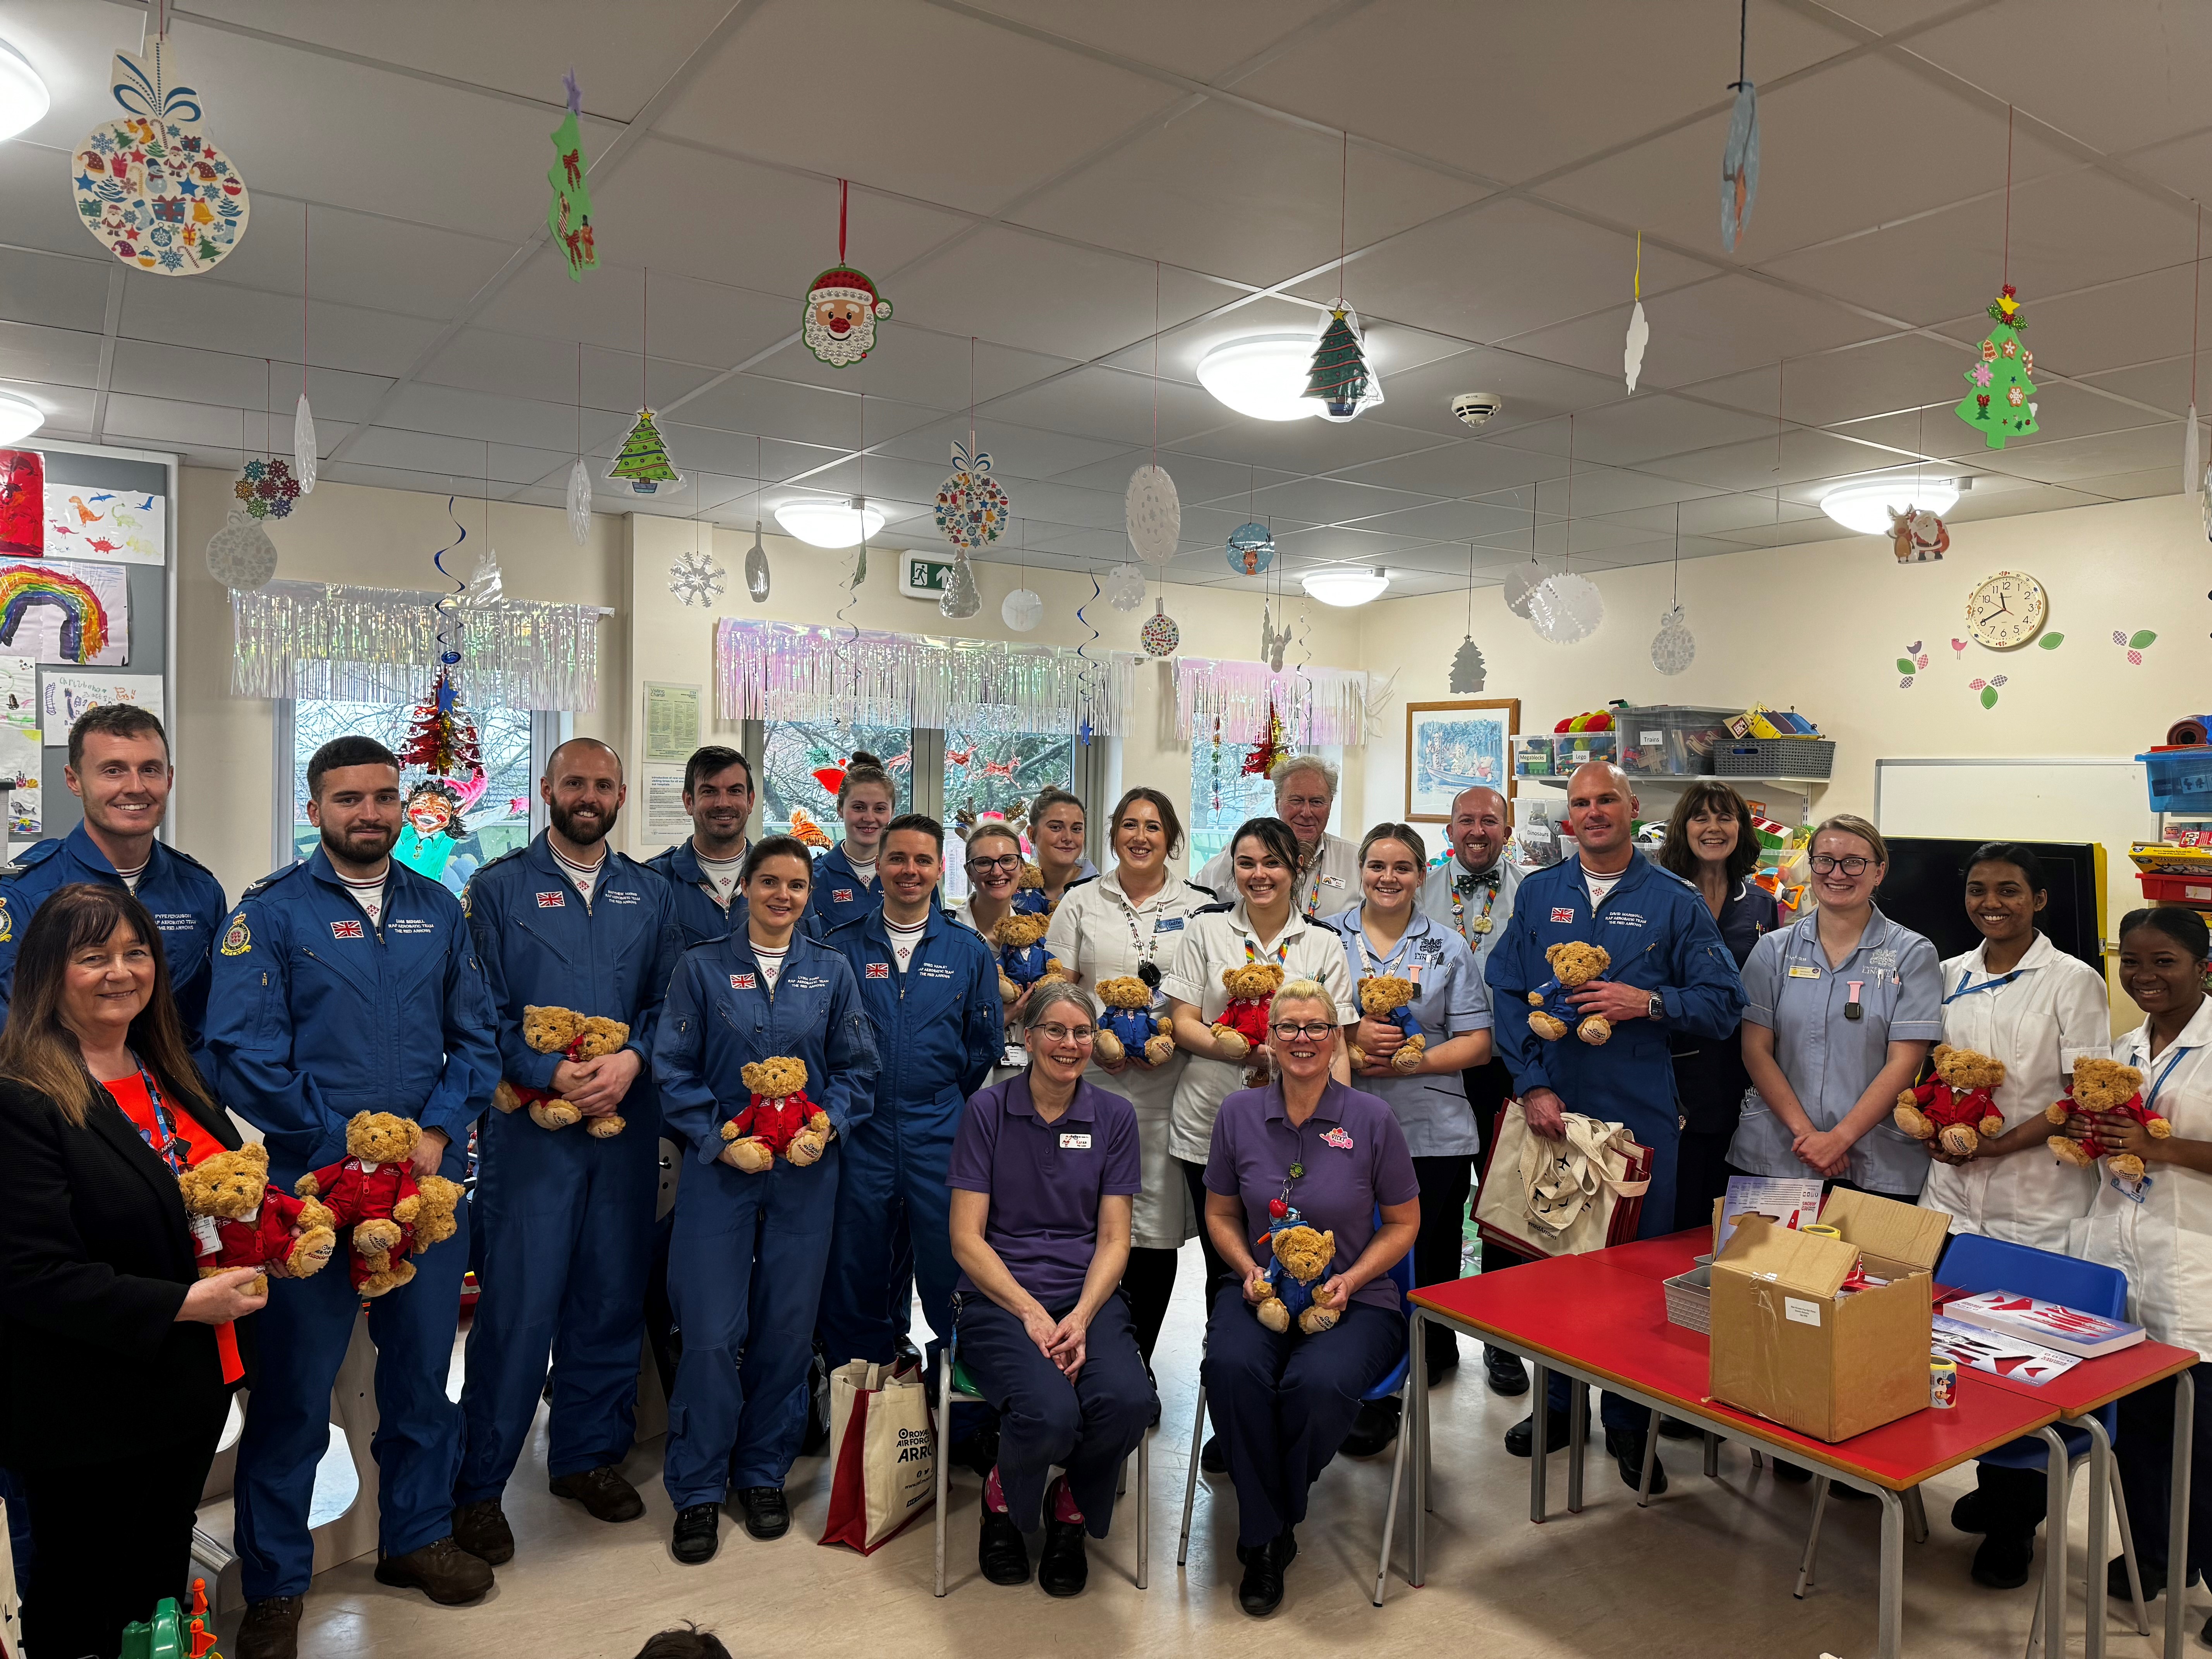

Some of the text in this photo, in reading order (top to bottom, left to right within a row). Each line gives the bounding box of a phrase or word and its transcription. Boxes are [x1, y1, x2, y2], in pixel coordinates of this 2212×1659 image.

[1992, 586, 1998, 594] 11
[2002, 582, 2011, 590] 12
[2017, 583, 2020, 591] 1
[1982, 595, 1990, 603] 10
[2024, 591, 2030, 599] 2
[1977, 607, 1984, 615] 9
[2028, 604, 2034, 612] 3
[2023, 616, 2028, 624] 4
[1989, 626, 1996, 634] 7
[2001, 629, 2006, 637] 6
[2013, 625, 2019, 633] 5
[1332, 1133, 1345, 1142] VICKI
[161, 1140, 174, 1153] NHS
[1528, 1221, 1557, 1240] #RedArrows
[909, 1428, 929, 1438] ROYAL
